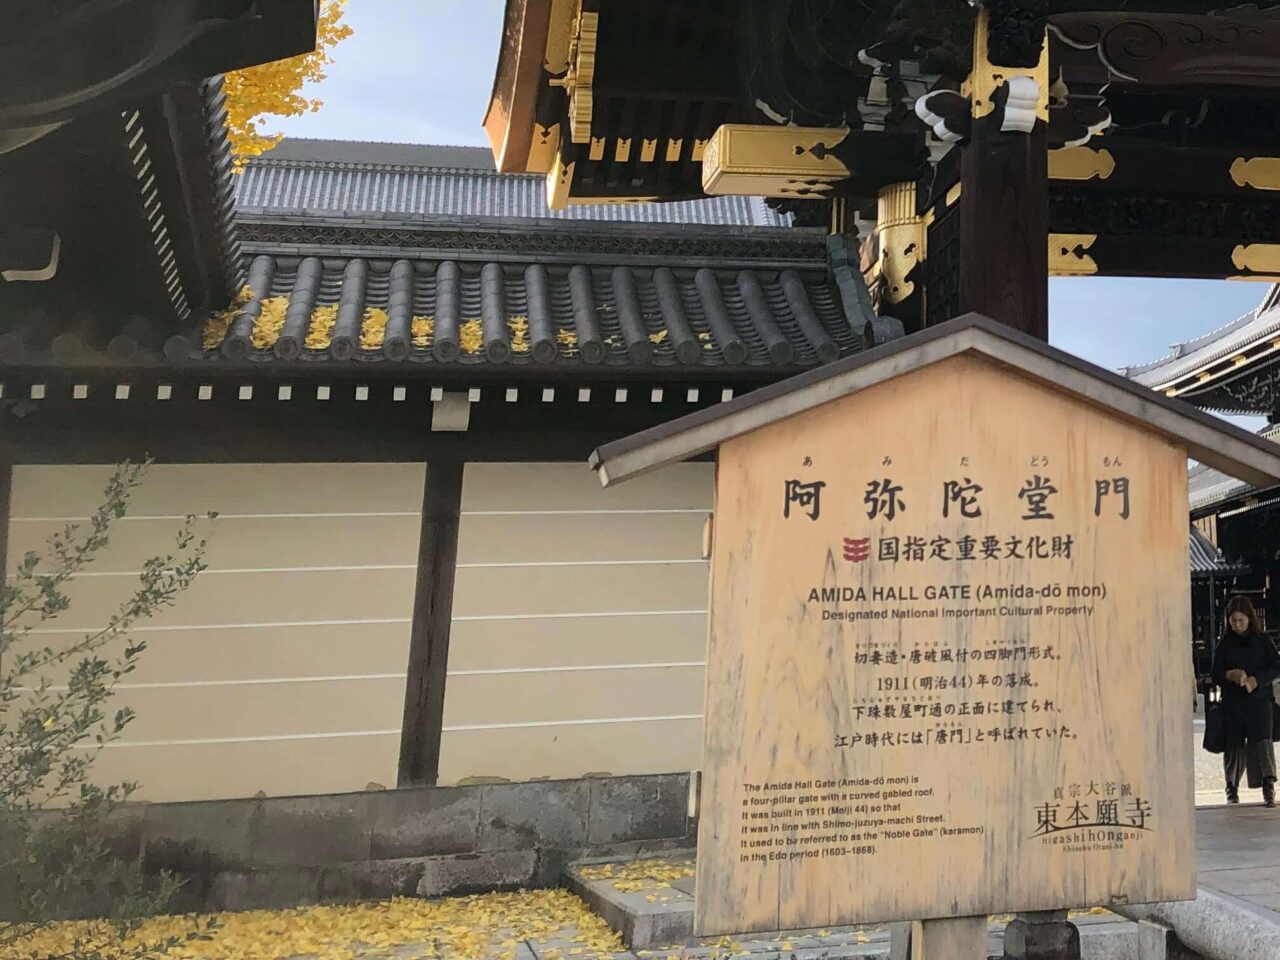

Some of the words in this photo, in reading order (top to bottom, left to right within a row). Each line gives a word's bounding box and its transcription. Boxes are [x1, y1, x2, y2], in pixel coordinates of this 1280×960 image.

[802, 456, 812, 466] あ
[882, 456, 892, 466] み
[1030, 455, 1049, 466] どう
[1102, 456, 1122, 466] もん
[783, 474, 1132, 521] 阿弥陀堂門
[877, 535, 1074, 563] 国指定重要文化財
[807, 585, 868, 603] AMIDA
[871, 585, 919, 602] HALL
[925, 584, 971, 601] GATE
[976, 584, 1062, 602] (Amida-dō
[1066, 583, 1107, 600] mon)
[822, 608, 888, 622] Designated
[891, 607, 939, 619] National
[941, 607, 997, 620] Important
[999, 606, 1043, 617] Cultural
[1046, 605, 1094, 618] Property
[743, 784, 760, 792] The
[763, 783, 792, 791] Amida
[795, 780, 812, 789] Hall
[815, 780, 836, 788] Gate
[887, 776, 909, 785] mon)
[1054, 780, 1133, 800] 真宗大谷派
[751, 796, 796, 806] four-pillar
[799, 794, 818, 804] gate
[821, 793, 839, 801] with
[850, 791, 880, 800] curved
[882, 789, 912, 800] gabled
[915, 788, 935, 797] roof.
[742, 812, 748, 820] It
[794, 808, 802, 817] in
[806, 808, 825, 816] 1911
[828, 806, 852, 816] (Meiji
[855, 805, 868, 814] 44)
[884, 804, 901, 812] that
[1033, 798, 1152, 834] 東本願寺
[771, 824, 779, 832] in
[782, 822, 798, 831] line
[801, 821, 820, 830] with
[823, 816, 914, 829] Shimo-juzuya-machi
[916, 815, 945, 823] Street.
[741, 840, 747, 848] It
[750, 838, 772, 847] used
[786, 836, 798, 845] be
[800, 834, 837, 844] referred
[851, 833, 861, 841] as
[863, 832, 877, 840] the
[940, 826, 984, 836] (karamon)
[752, 852, 767, 862] the
[769, 851, 787, 861] Edo
[790, 849, 819, 860] period
